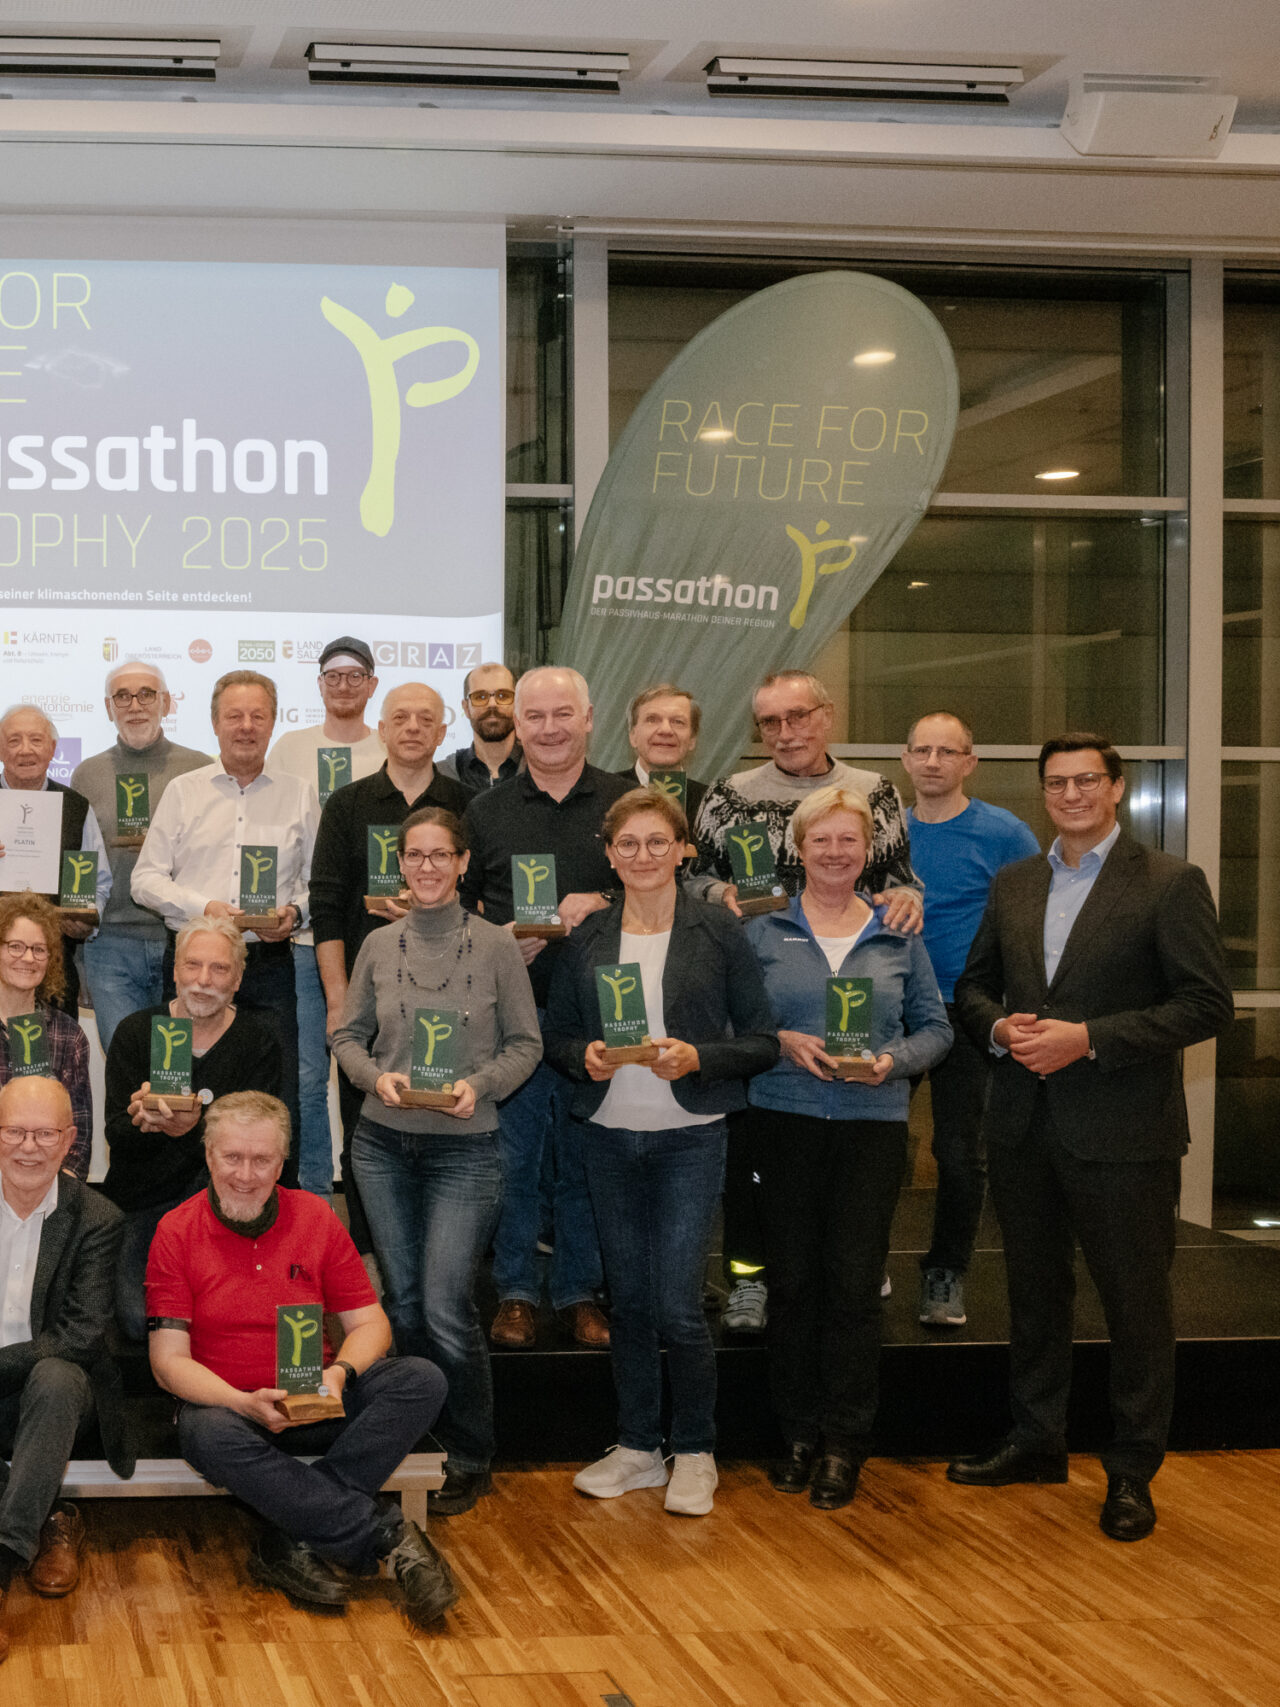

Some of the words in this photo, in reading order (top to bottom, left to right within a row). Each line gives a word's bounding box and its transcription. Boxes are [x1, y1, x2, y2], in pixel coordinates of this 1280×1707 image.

[659, 400, 800, 447] RACE
[817, 406, 929, 455] FOR
[653, 451, 870, 506] FUTURE
[182, 515, 329, 572] 2025
[37, 587, 143, 602] klimaschonenden
[146, 588, 179, 602] Seite
[182, 589, 252, 604] entdecken!
[592, 573, 780, 611] passathon
[744, 618, 776, 629] REGION
[23, 630, 78, 645] KÄRNTEN
[297, 640, 324, 650] LAND
[240, 648, 275, 661] 2050
[297, 651, 321, 660] SALZ
[375, 643, 478, 668] GRAZ
[279, 708, 299, 723] IG
